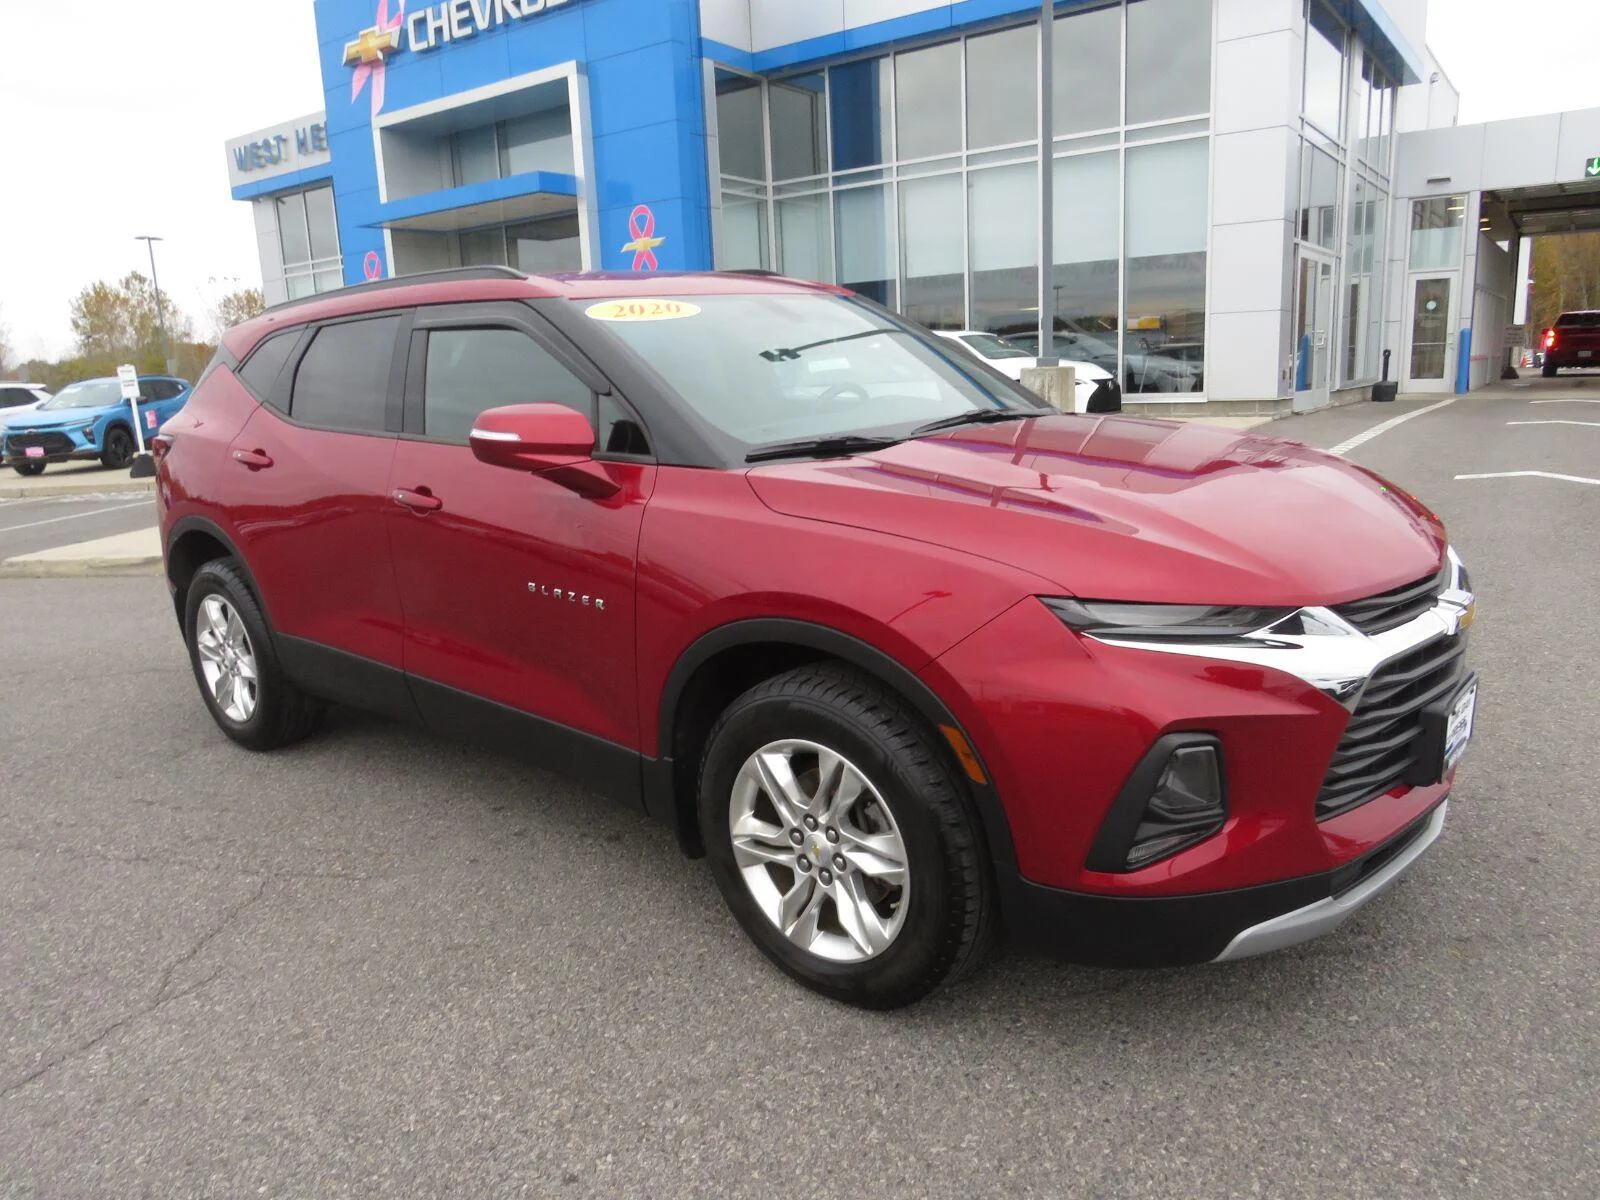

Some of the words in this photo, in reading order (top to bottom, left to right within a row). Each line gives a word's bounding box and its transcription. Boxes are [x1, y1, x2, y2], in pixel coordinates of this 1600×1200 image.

[233, 134, 286, 172] WEST
[296, 121, 328, 156] HE
[613, 303, 681, 318] 2020
[527, 581, 605, 610] BLAZER
